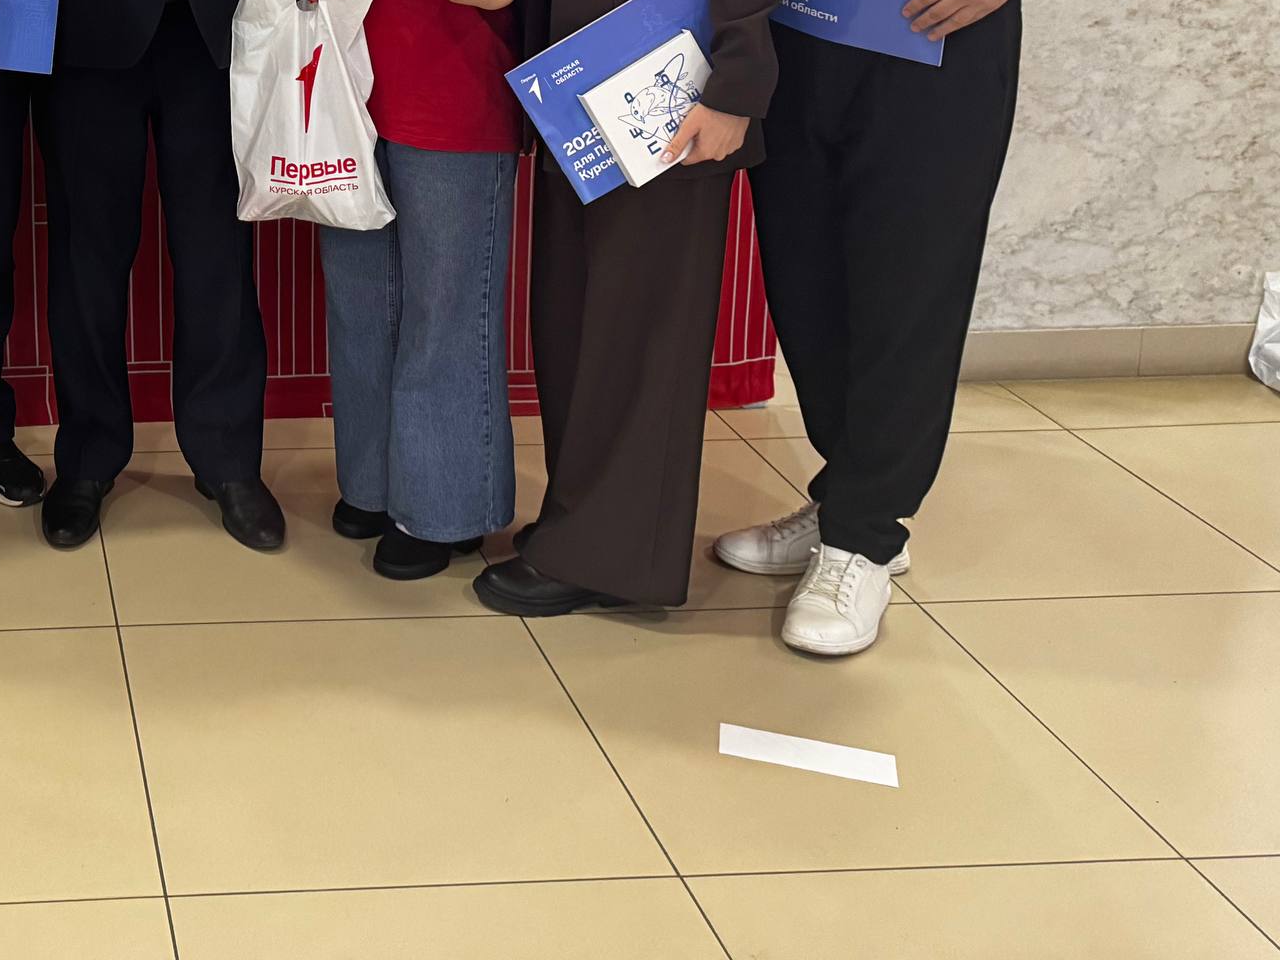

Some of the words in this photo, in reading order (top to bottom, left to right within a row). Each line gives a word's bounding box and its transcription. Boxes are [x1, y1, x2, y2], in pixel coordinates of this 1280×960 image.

[791, 2, 838, 23] области
[551, 59, 580, 79] КУРСКАЯ
[555, 66, 584, 85] ОБЛАСТЬ
[270, 155, 357, 186] Первые
[573, 152, 595, 171] для
[578, 156, 615, 181] Курск
[269, 185, 313, 196] КУРСКАЯ
[314, 183, 359, 194] ОБЛАСТЬ
